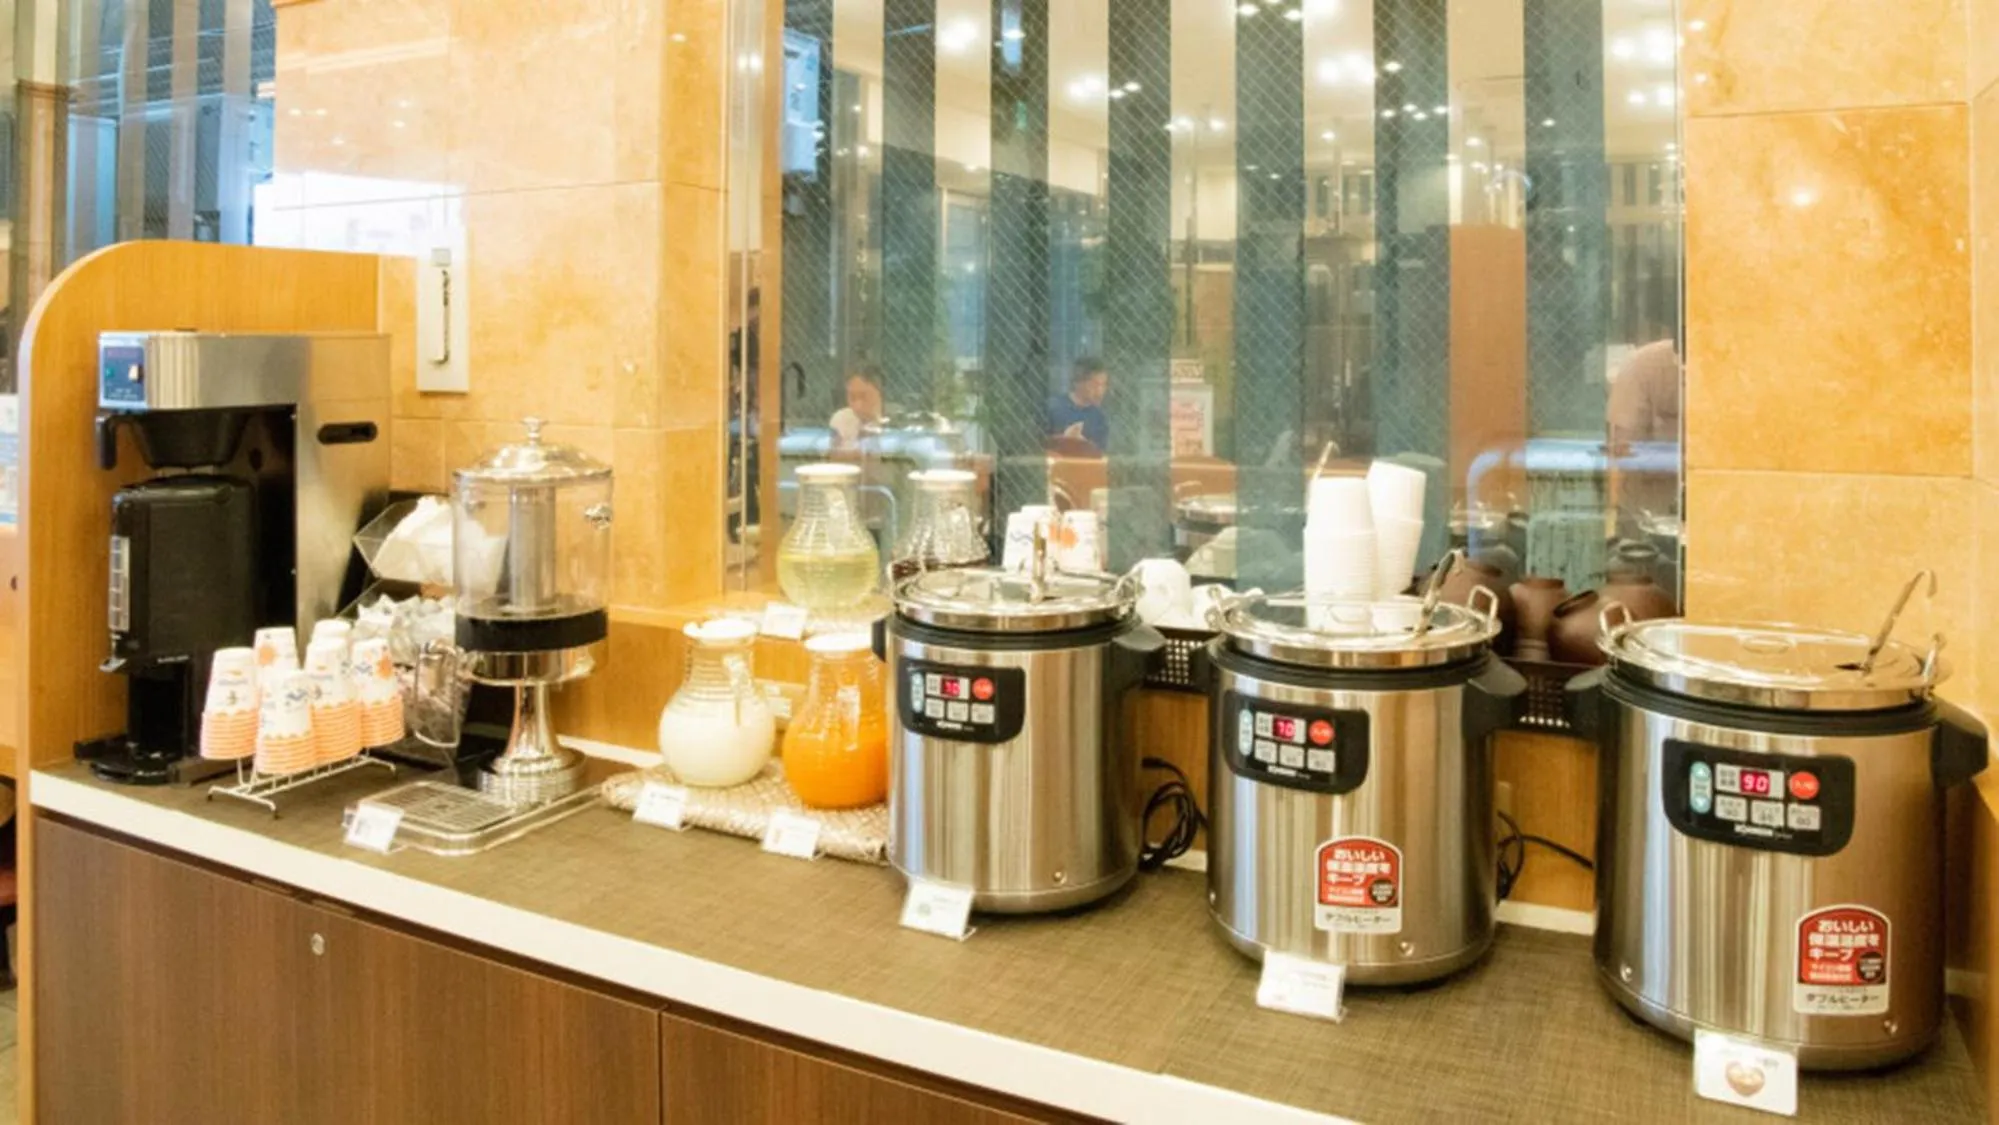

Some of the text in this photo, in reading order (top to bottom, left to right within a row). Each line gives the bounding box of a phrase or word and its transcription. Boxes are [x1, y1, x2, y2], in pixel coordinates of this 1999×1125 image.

[1743, 773, 1769, 792] 90
[1818, 919, 1875, 933] おいしい
